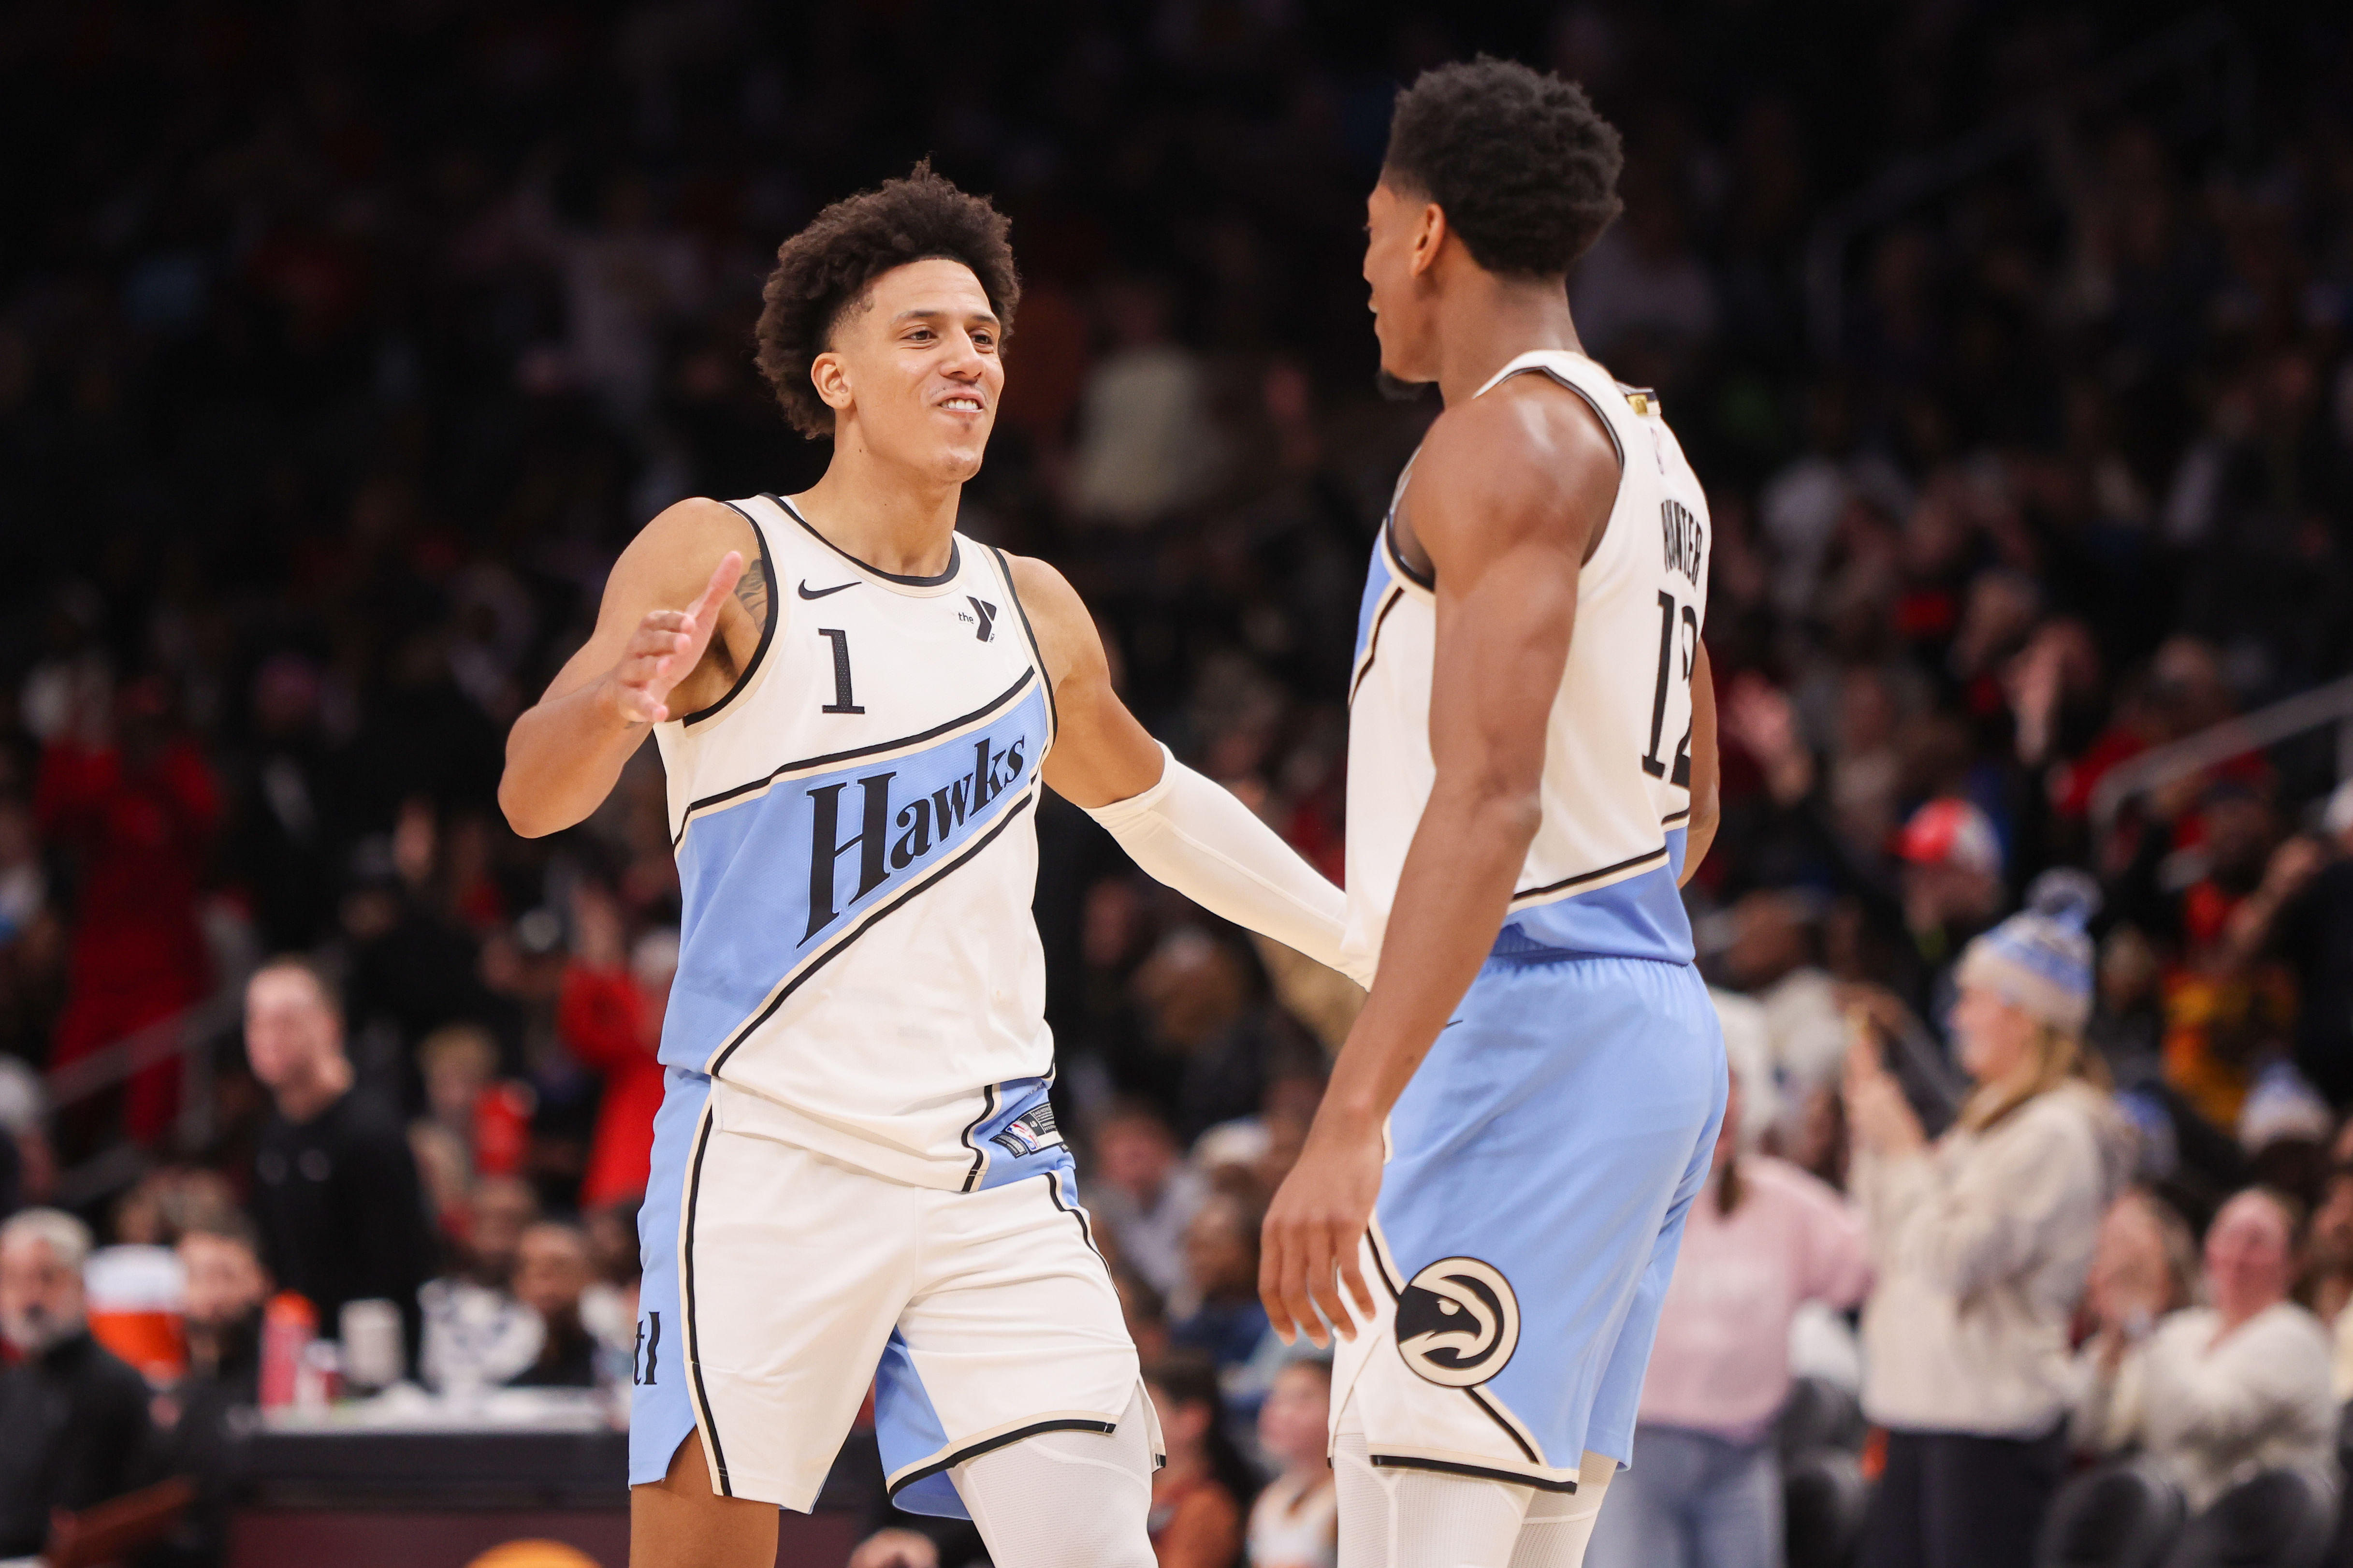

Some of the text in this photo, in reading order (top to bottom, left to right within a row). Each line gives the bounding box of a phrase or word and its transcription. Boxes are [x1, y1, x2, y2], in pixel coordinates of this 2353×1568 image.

[818, 628, 865, 714] 1
[958, 612, 974, 624] the
[1641, 590, 1697, 788] 12
[796, 735, 1025, 950] Hawks
